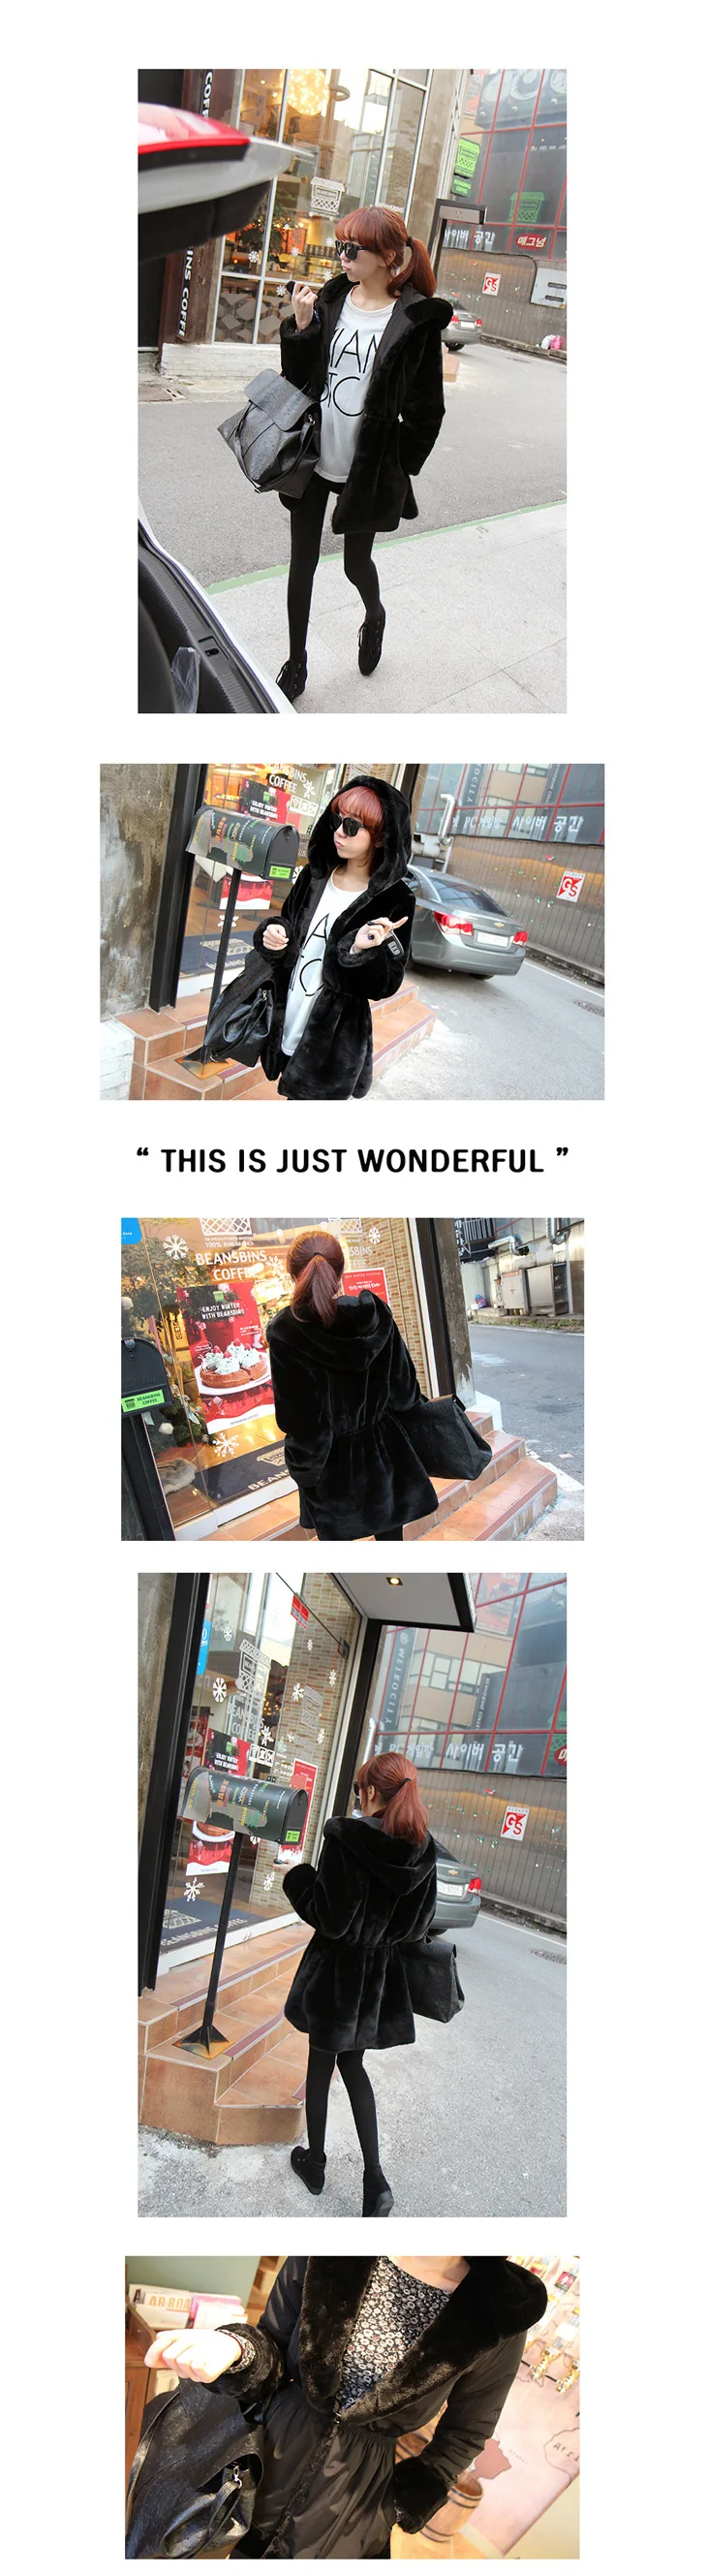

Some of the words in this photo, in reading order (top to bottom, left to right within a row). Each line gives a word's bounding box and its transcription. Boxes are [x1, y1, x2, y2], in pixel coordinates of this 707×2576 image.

[269, 774, 297, 794] COFFEE
[511, 815, 548, 831] 사이버
[554, 815, 584, 832] 공간
[195, 1250, 267, 1266] BEANSBINS
[350, 1246, 373, 1257] SBINS
[201, 1304, 220, 1313] ENJOY
[220, 1302, 240, 1310] WINTER
[216, 1308, 245, 1318] BEANSBINS
[446, 1742, 484, 1761] 사이버
[492, 1743, 523, 1762] 공간
[505, 1813, 523, 1836] GS
